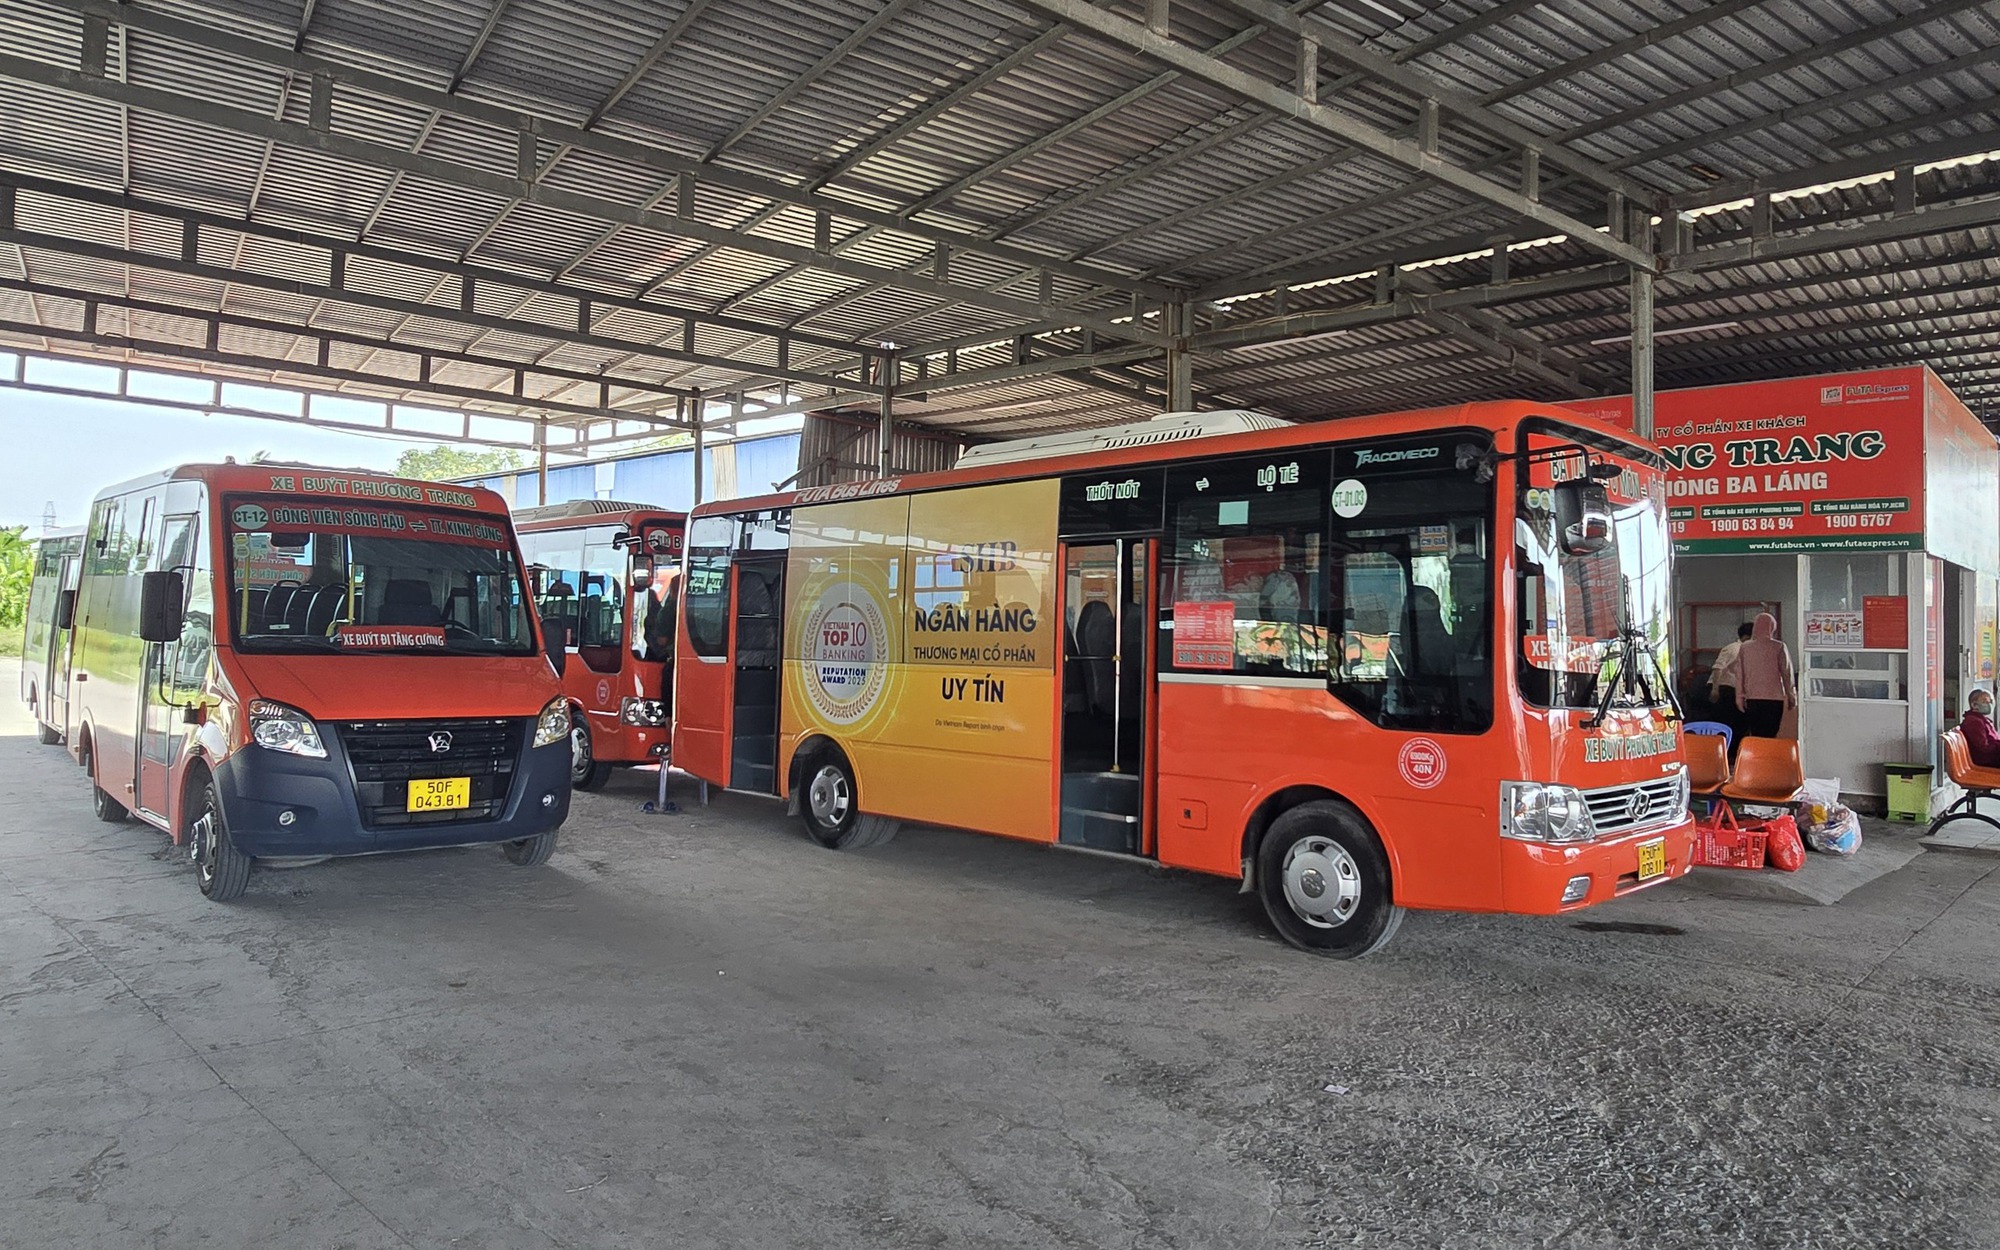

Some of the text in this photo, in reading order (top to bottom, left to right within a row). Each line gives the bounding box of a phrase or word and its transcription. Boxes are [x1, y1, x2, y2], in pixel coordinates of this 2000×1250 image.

[1874, 385, 1910, 395] Express
[1656, 413, 1807, 439] TY CỔ PHẦN XE KHÁCH
[1353, 447, 1440, 469] TRACOMECO
[1724, 430, 1886, 468] TRANG
[1257, 464, 1276, 492] LỘ
[1726, 475, 1758, 495] BA
[1764, 470, 1828, 493] LÁNG
[271, 475, 477, 507] XE BUÝT PHƯƠNG TRANG
[792, 479, 902, 504] FUTA Bus Lines
[1086, 479, 1141, 501] THỐT NỐT
[233, 509, 268, 524] CT-12
[272, 505, 310, 525] CÔNG
[312, 507, 341, 526] VIÊN
[345, 508, 377, 528] SÔNG
[381, 514, 406, 534] HẬU
[445, 520, 474, 538] KINH
[1711, 516, 1794, 532] 1900 63 84 94
[1825, 513, 1894, 528] 1900 6767
[1749, 539, 1816, 550] www.futabus.vn
[1821, 538, 1910, 550] www.futaexpress.vn
[959, 541, 1017, 574] SHB
[914, 604, 1037, 633] NGÂN HÀNG
[343, 633, 355, 645] XE
[356, 632, 379, 646] BUÝT
[380, 633, 391, 646] ĐI
[392, 631, 414, 646] TĂNG
[823, 622, 867, 647] TOP 10
[823, 649, 866, 660] BANKING
[914, 642, 1036, 664] THƯƠNG MẠI CỔ PHẦN
[1531, 640, 1548, 657] XE
[822, 667, 866, 677] REPUTATION
[822, 676, 866, 686] AWARD 2025
[942, 674, 1005, 703] UY TÍN
[1584, 737, 1600, 763] XE
[1413, 764, 1432, 774] 40N
[427, 781, 453, 794] 50F
[416, 794, 461, 808] 043.81
[1645, 844, 1658, 860] 50F
